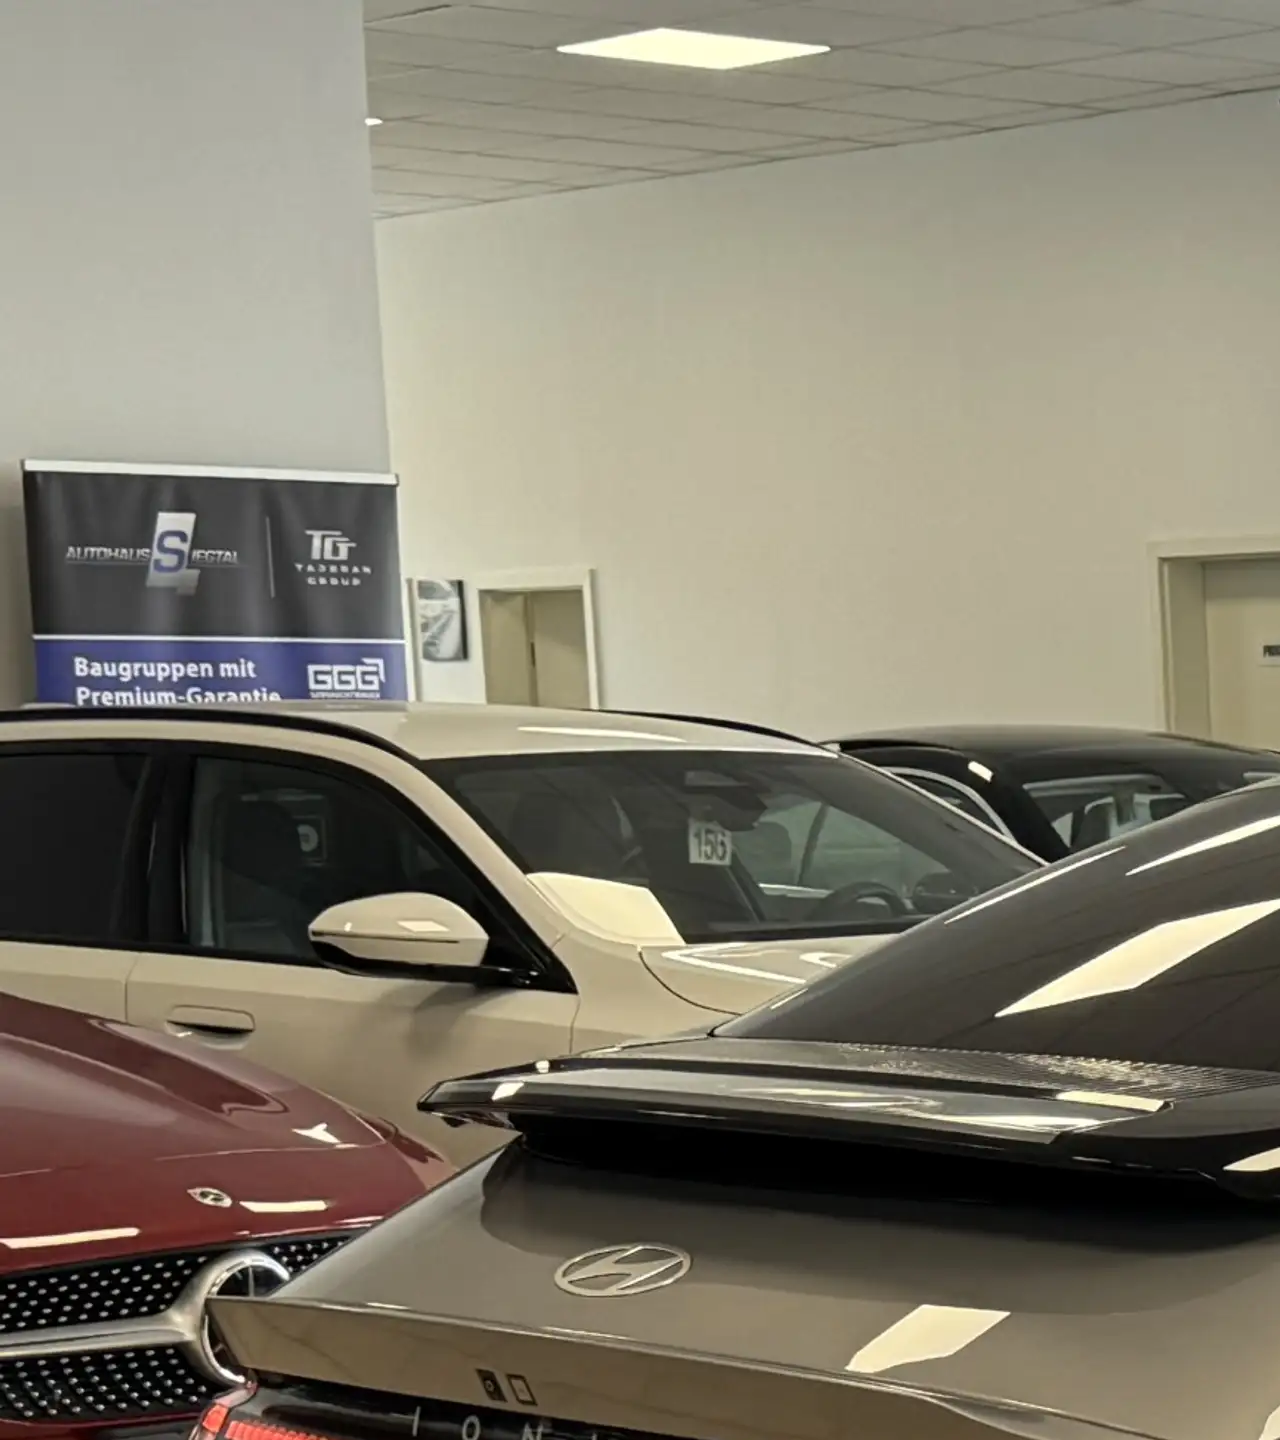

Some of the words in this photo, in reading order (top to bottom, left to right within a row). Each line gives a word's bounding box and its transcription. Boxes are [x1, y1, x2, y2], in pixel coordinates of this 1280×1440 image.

[66, 546, 150, 563] AUTOHAUS
[73, 656, 213, 682] Baugruppen
[219, 658, 257, 679] mit
